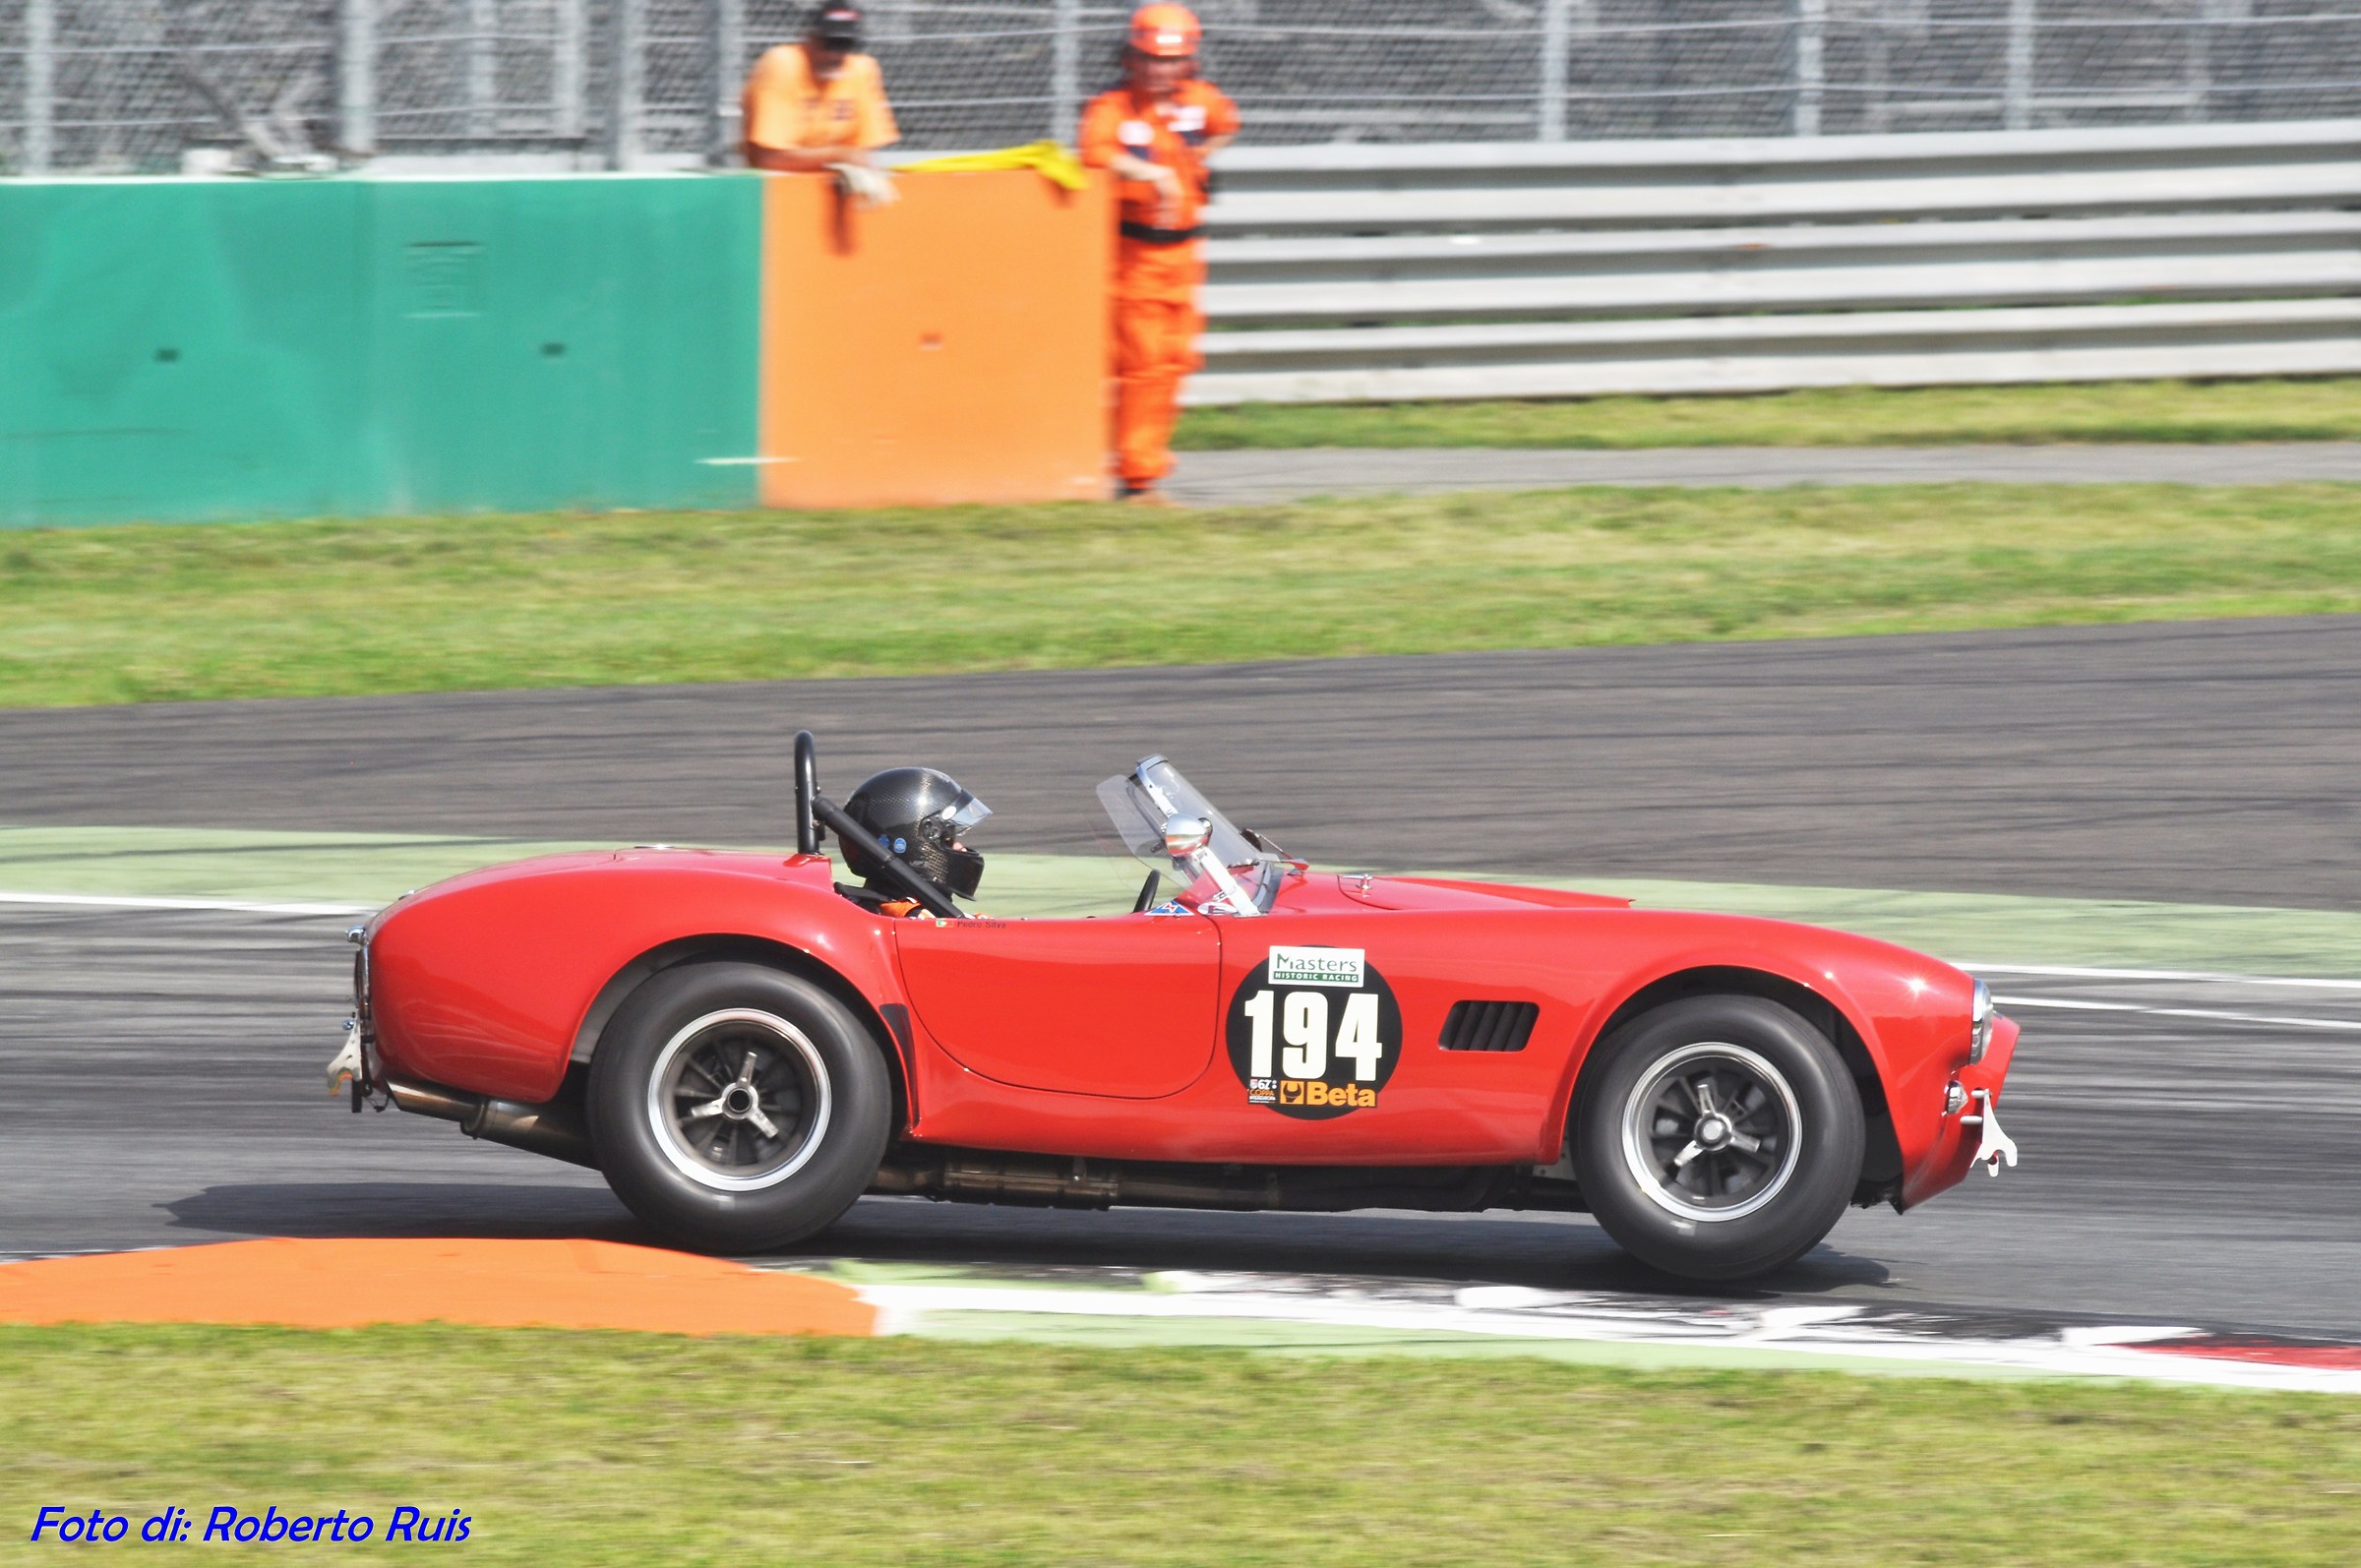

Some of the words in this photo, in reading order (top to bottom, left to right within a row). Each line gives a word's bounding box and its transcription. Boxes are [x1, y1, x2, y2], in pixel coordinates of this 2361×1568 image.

[1277, 953, 1357, 972] Masters
[1275, 972, 1318, 981] HISTORIC
[1244, 990, 1382, 1082] 194
[1306, 1081, 1376, 1107] Beta
